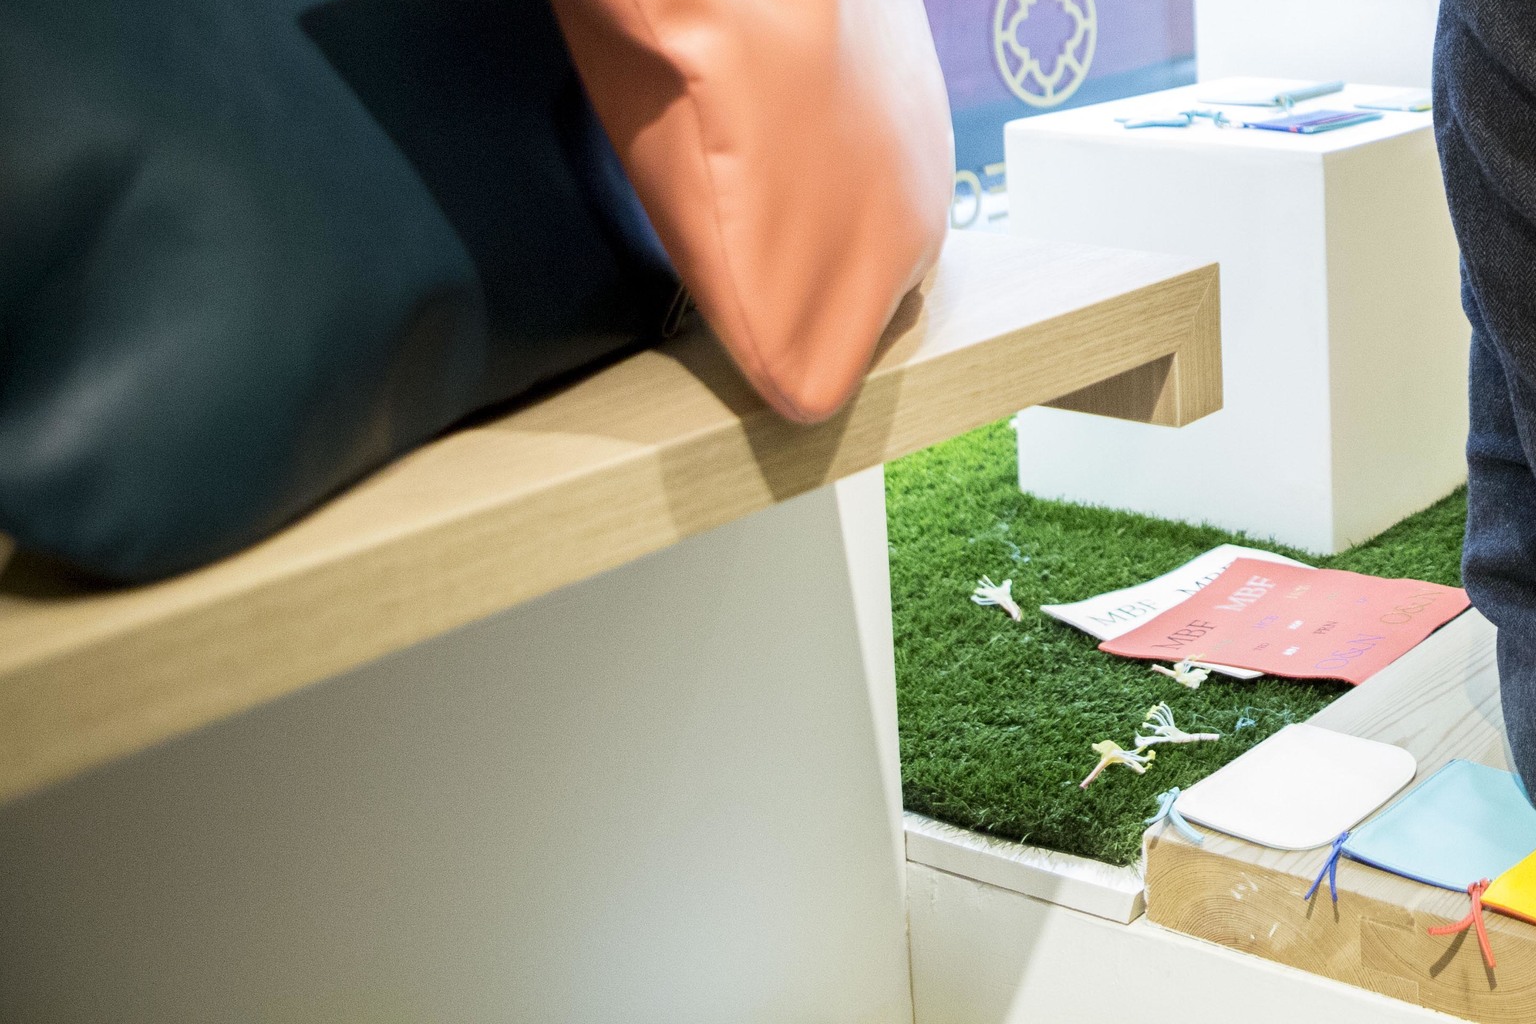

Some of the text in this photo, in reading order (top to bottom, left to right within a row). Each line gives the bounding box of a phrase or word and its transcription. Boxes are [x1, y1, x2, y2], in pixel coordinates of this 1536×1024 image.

[1214, 574, 1278, 613] MBF
[1087, 599, 1157, 627] MBF
[1151, 619, 1217, 651] MBF
